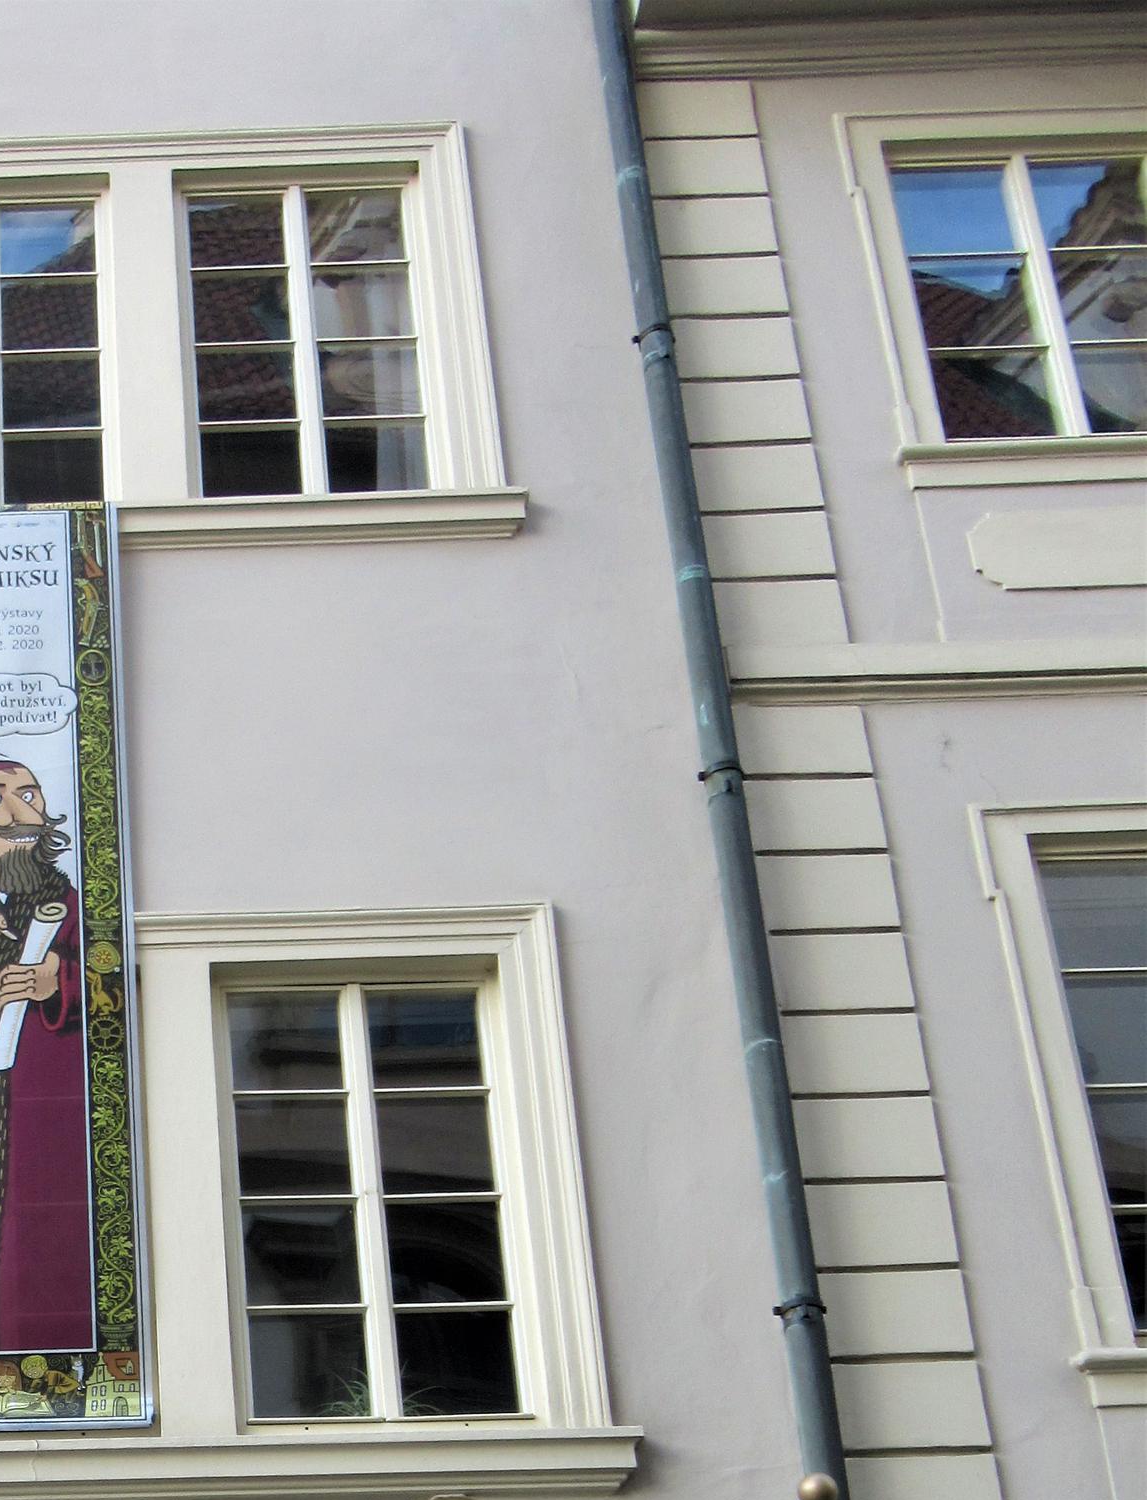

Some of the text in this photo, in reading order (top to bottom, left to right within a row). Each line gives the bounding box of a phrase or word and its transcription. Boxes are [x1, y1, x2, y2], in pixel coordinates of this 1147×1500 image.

[8, 624, 40, 636] 2020
[12, 639, 44, 650] 2020
[21, 680, 43, 695] byl
[0, 711, 58, 727] podívat!
